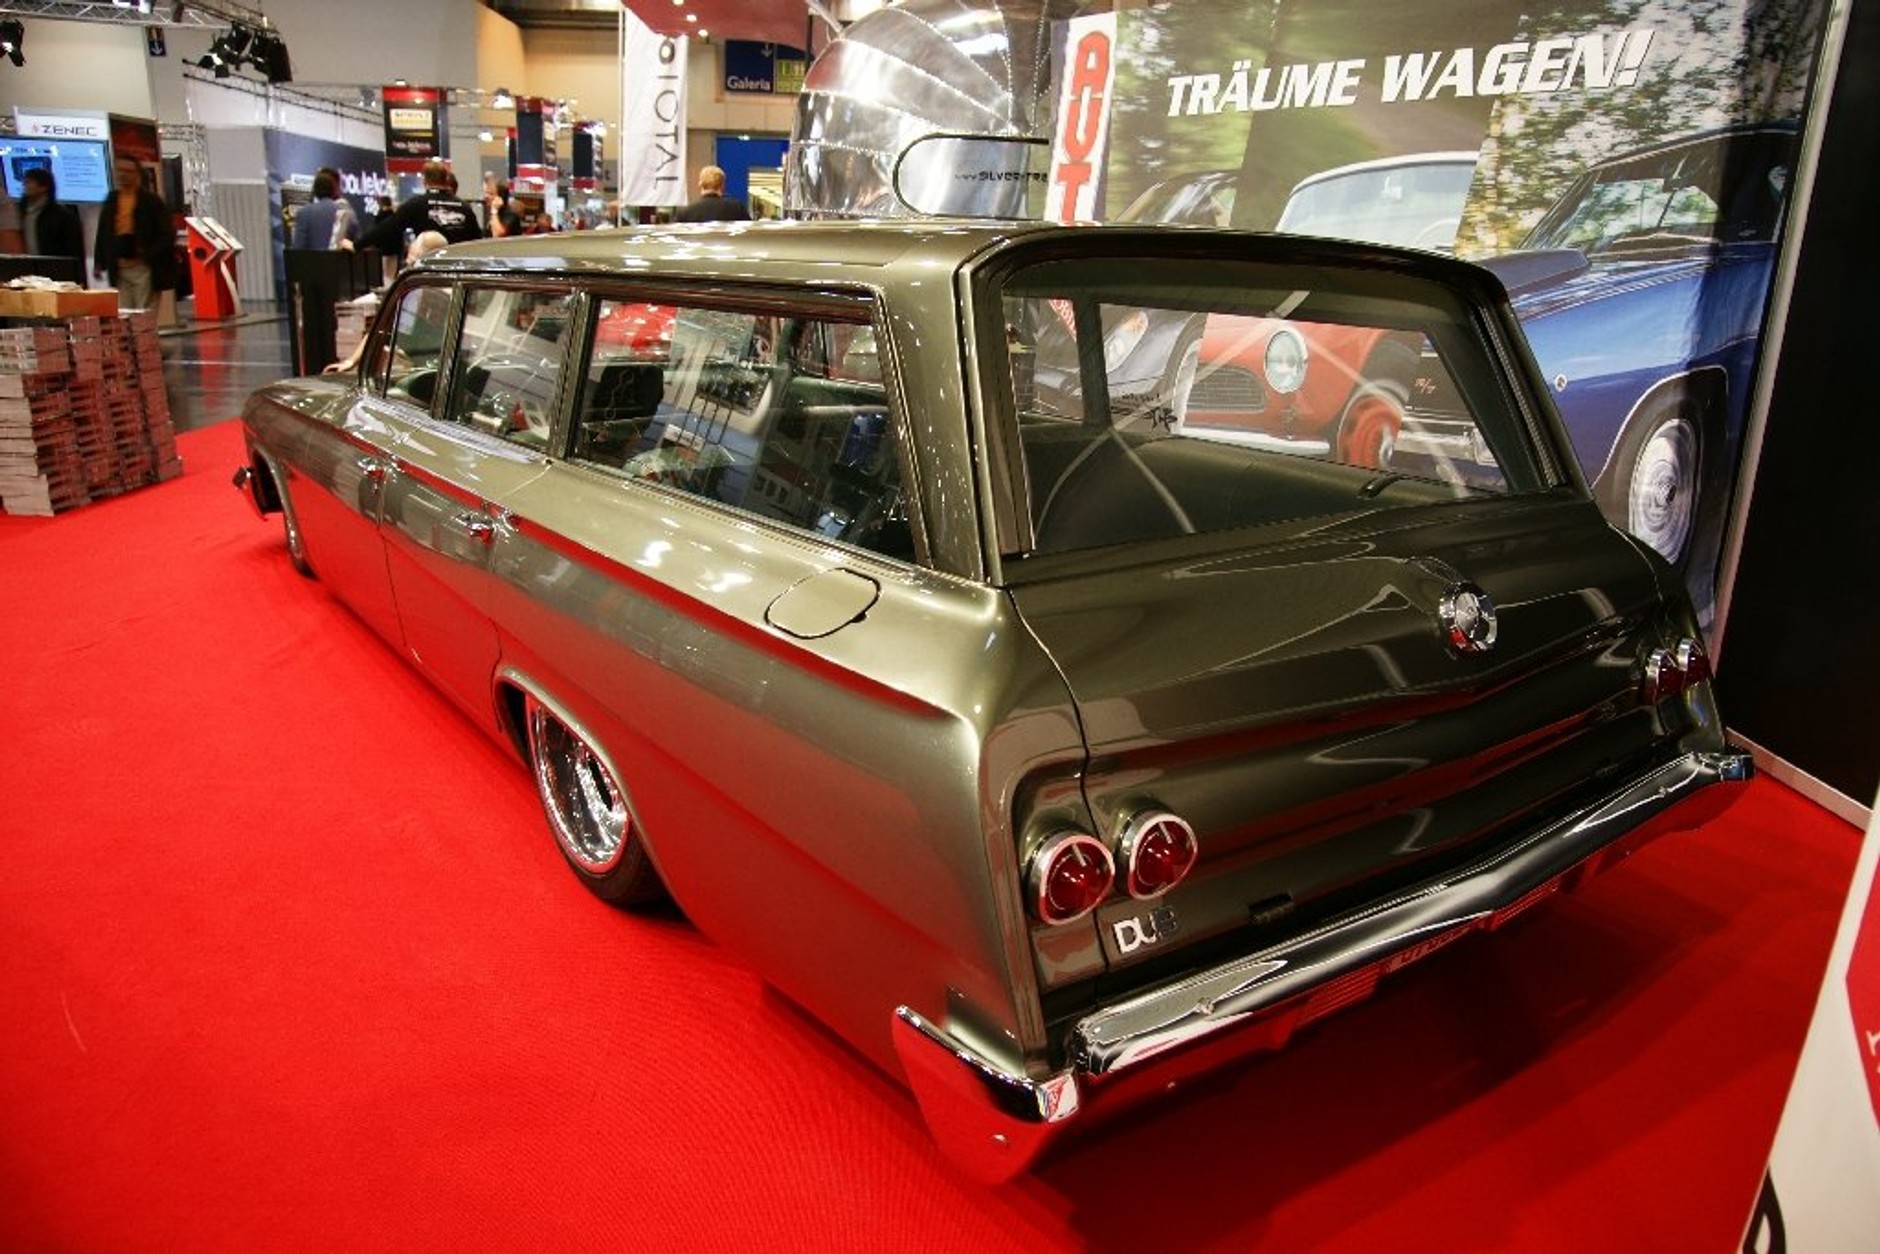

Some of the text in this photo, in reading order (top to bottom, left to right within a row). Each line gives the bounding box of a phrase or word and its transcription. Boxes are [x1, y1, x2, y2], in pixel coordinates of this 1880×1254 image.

[727, 76, 771, 91] Galeria
[1167, 30, 1655, 117] TRÄUME WAGEN!
[41, 125, 98, 136] ZENEC
[1057, 30, 1110, 226] AUT
